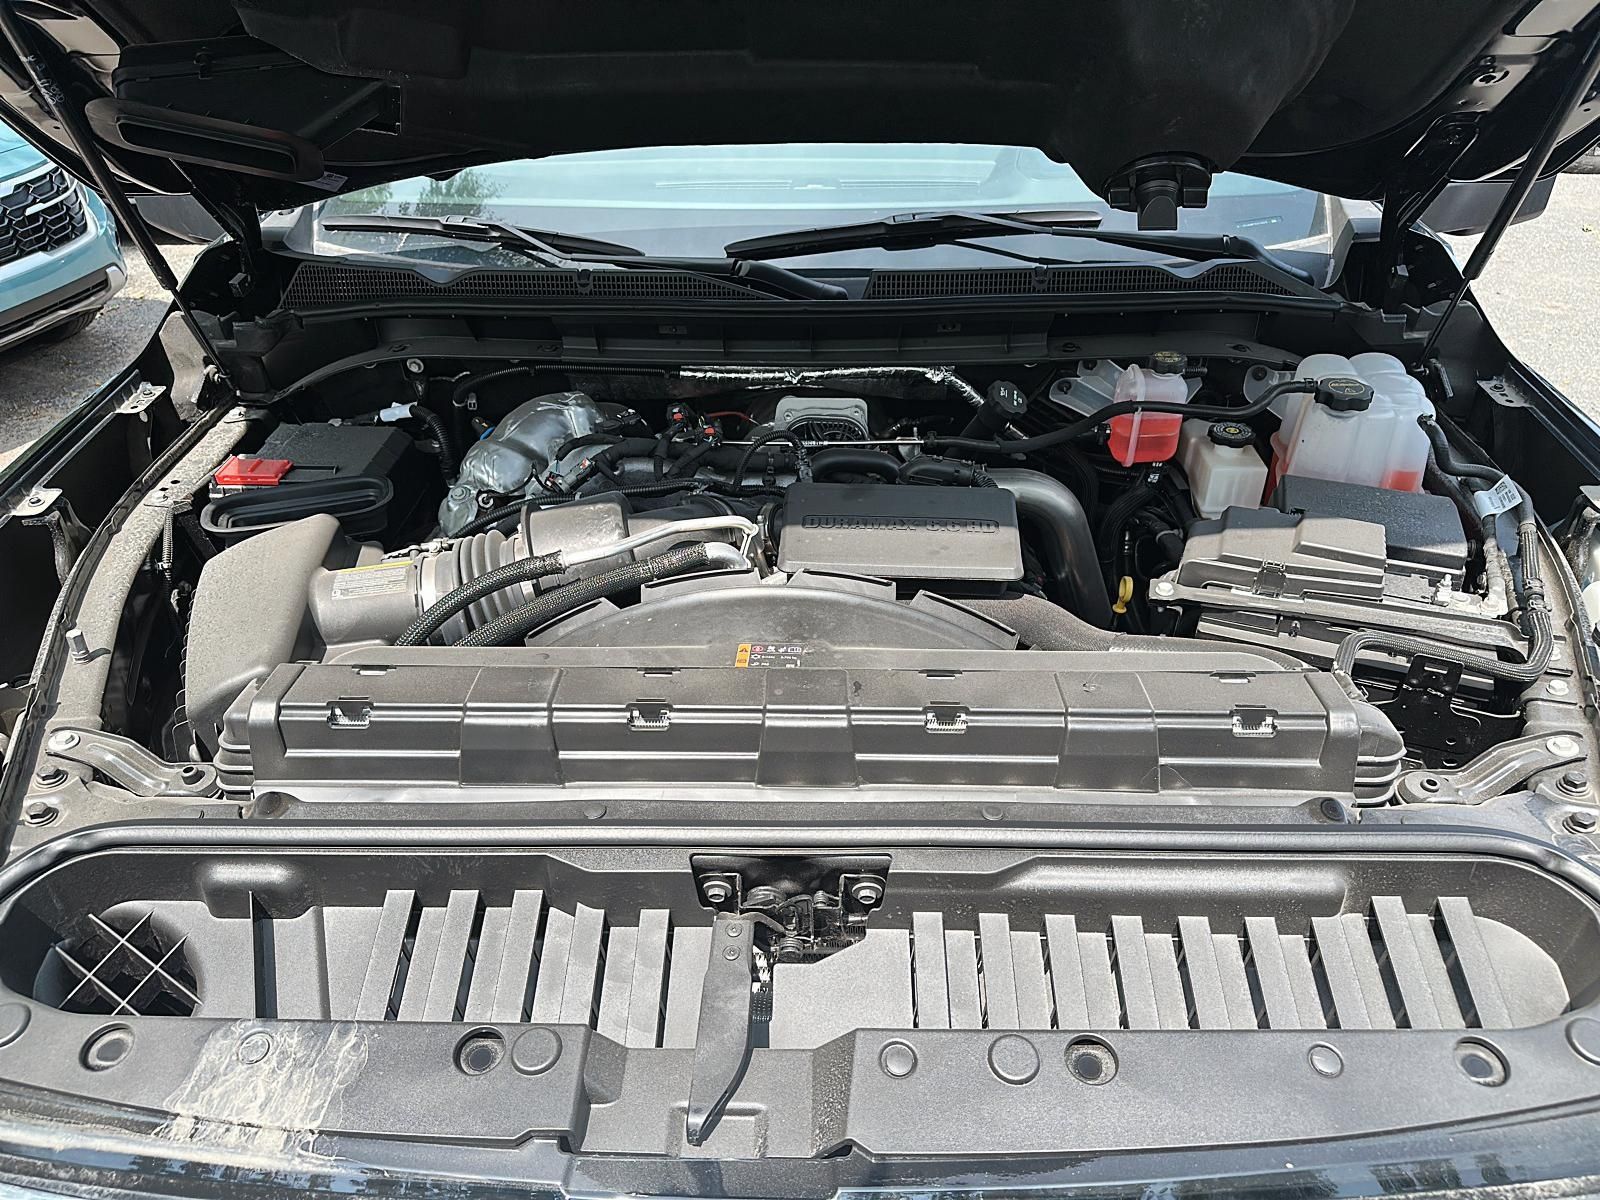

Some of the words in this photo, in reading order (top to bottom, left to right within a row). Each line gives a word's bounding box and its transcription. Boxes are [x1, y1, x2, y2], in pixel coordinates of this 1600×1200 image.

[804, 516, 917, 531] DURAMAX
[926, 518, 961, 532] 6.6
[966, 519, 997, 534] HD
